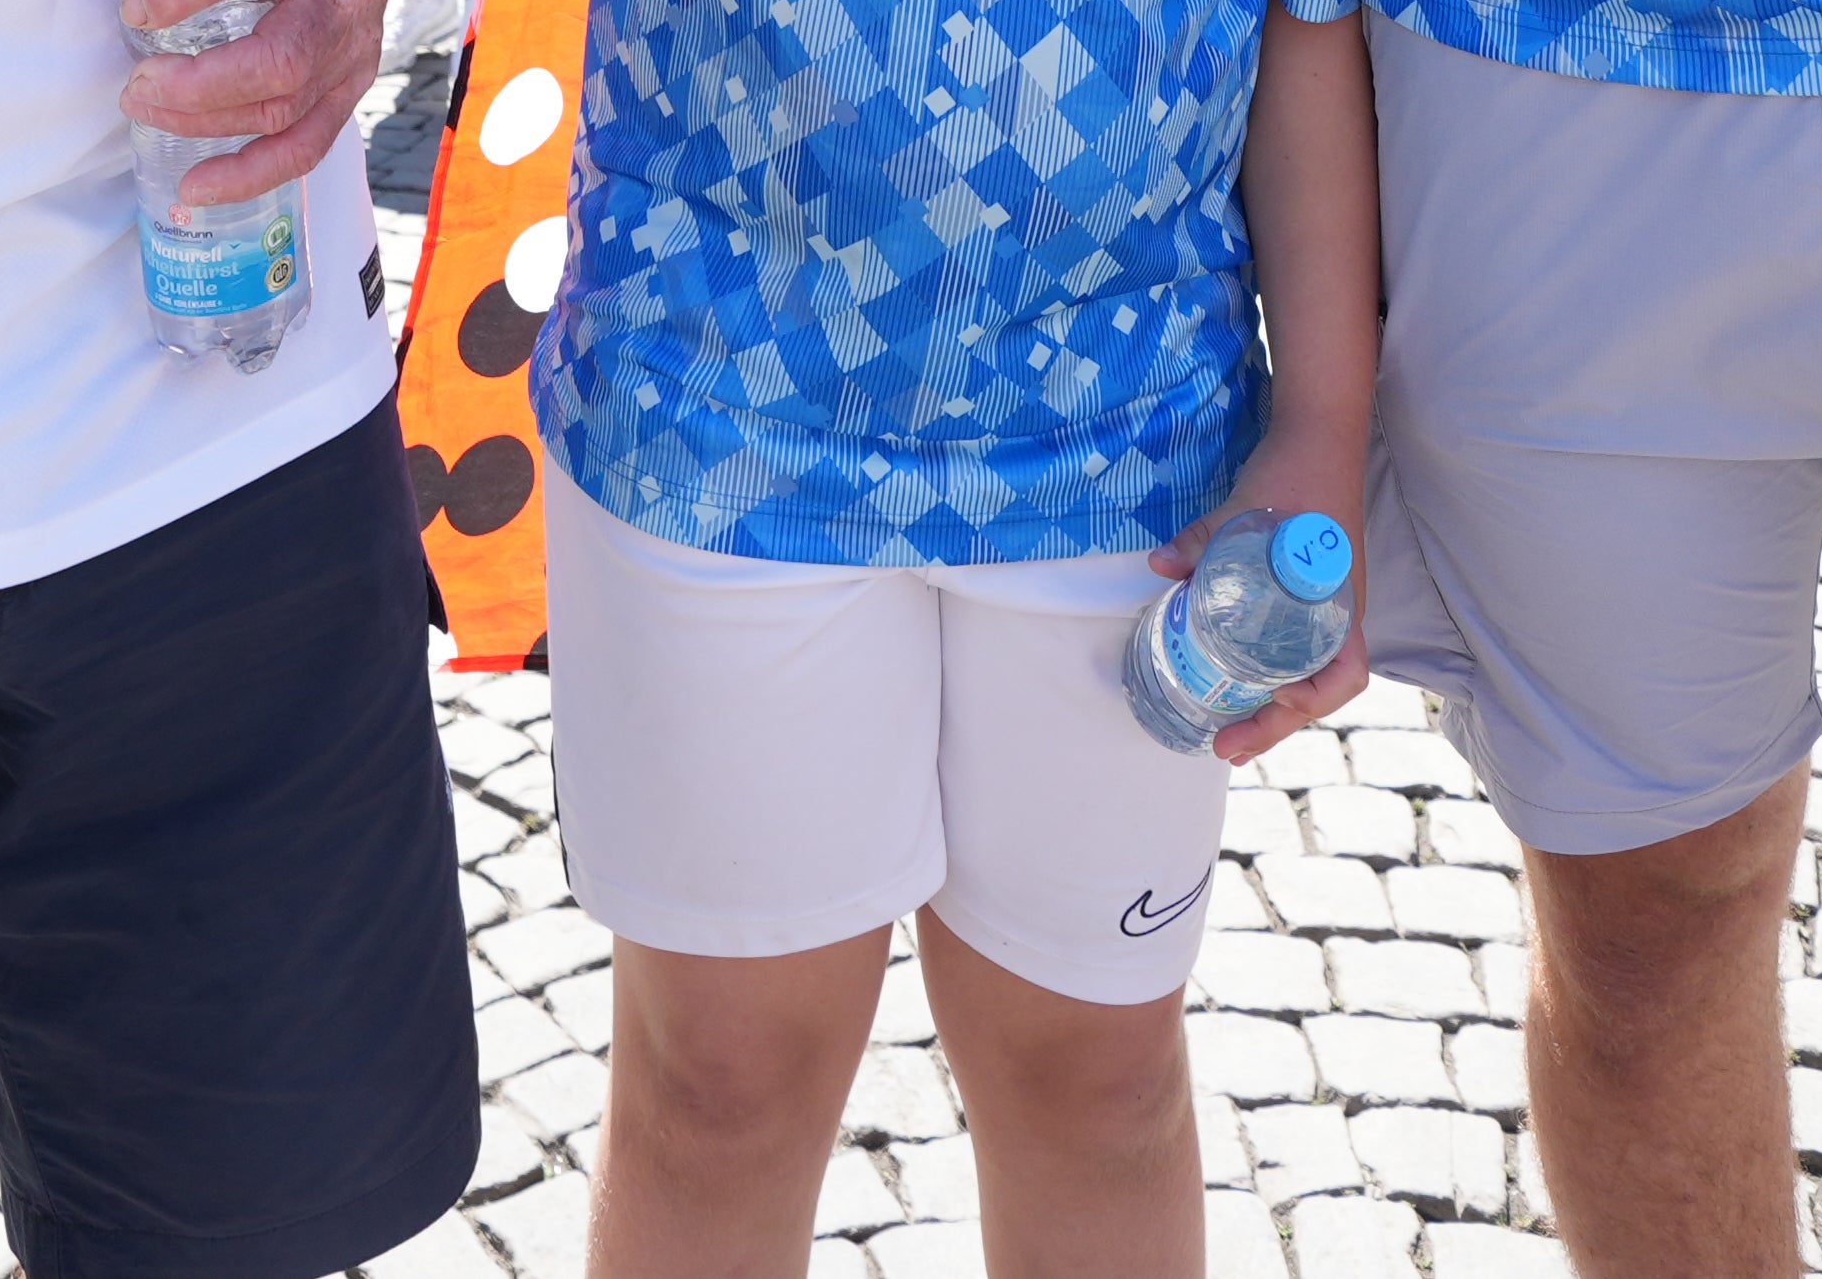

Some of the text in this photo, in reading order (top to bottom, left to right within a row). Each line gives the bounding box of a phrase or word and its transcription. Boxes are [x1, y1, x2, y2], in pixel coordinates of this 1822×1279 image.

[154, 221, 213, 239] Quellbrunn
[151, 238, 222, 263] Naturell
[156, 273, 218, 297] Quelle
